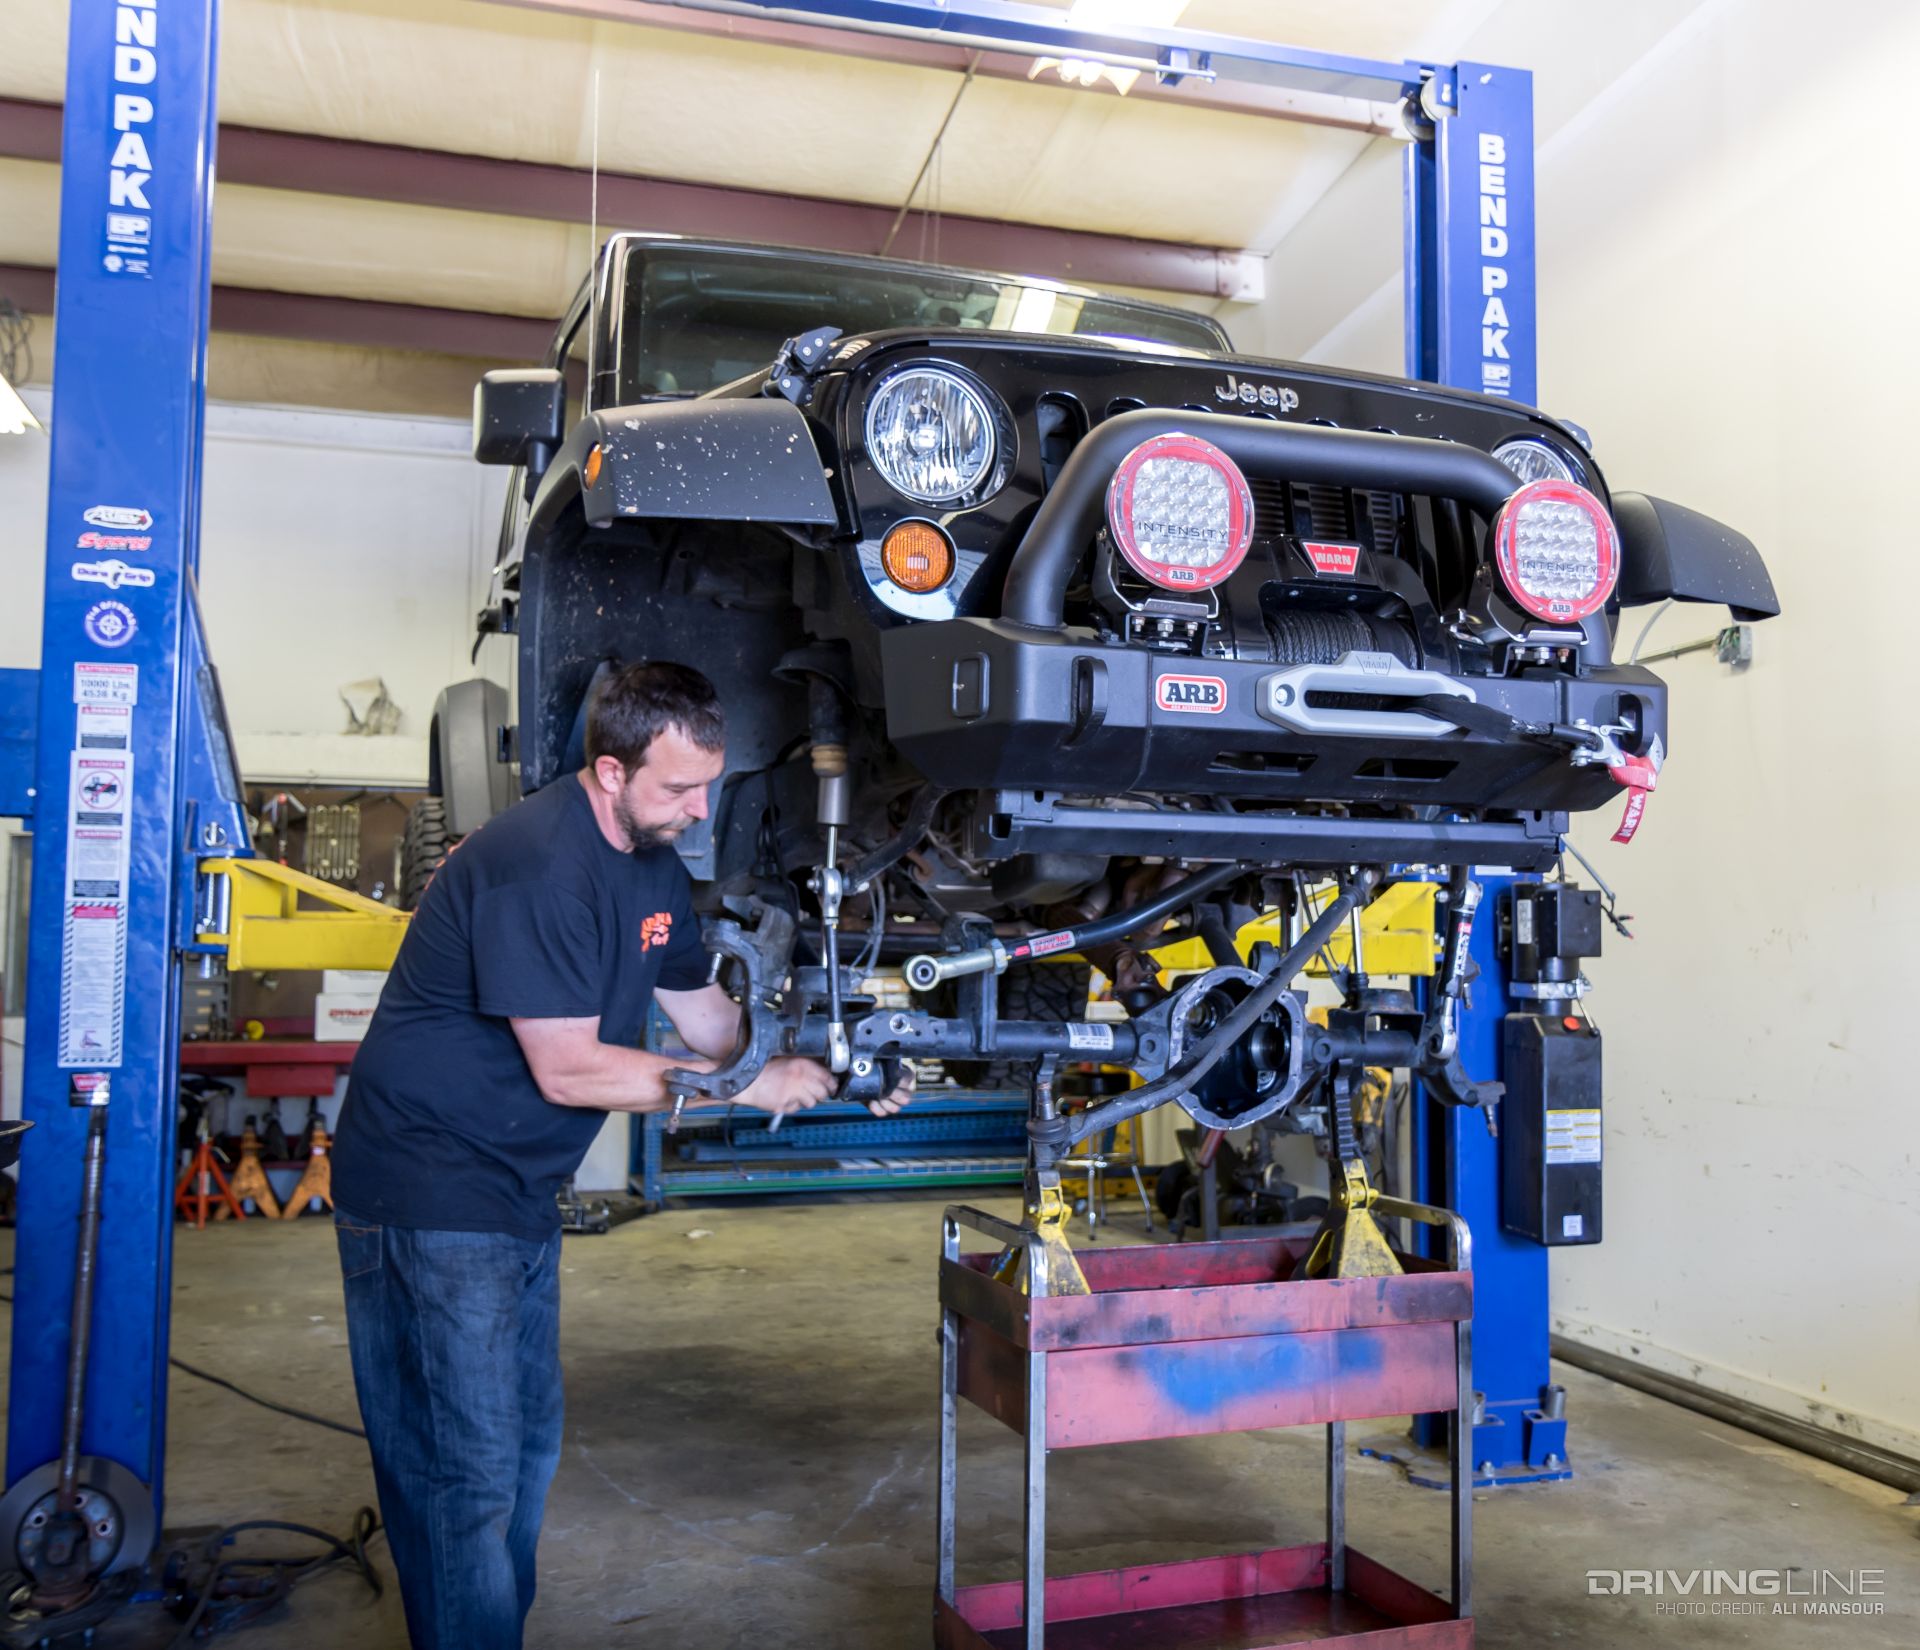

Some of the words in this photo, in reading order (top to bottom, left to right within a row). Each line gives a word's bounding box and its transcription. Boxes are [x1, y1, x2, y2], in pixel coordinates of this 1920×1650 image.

[115, 0, 157, 84] ND
[110, 94, 153, 209] PAK
[1478, 132, 1508, 257] BEND
[1482, 266, 1510, 359] PAK
[1215, 374, 1299, 413] Jeep
[1138, 521, 1229, 540] INTENSITY
[1314, 552, 1352, 566] WARN
[1521, 560, 1599, 574] INTENSITY
[1171, 570, 1195, 582] ARB
[1551, 603, 1571, 614] ARB
[1165, 683, 1219, 704] ARB
[1619, 793, 1644, 837] WARN
